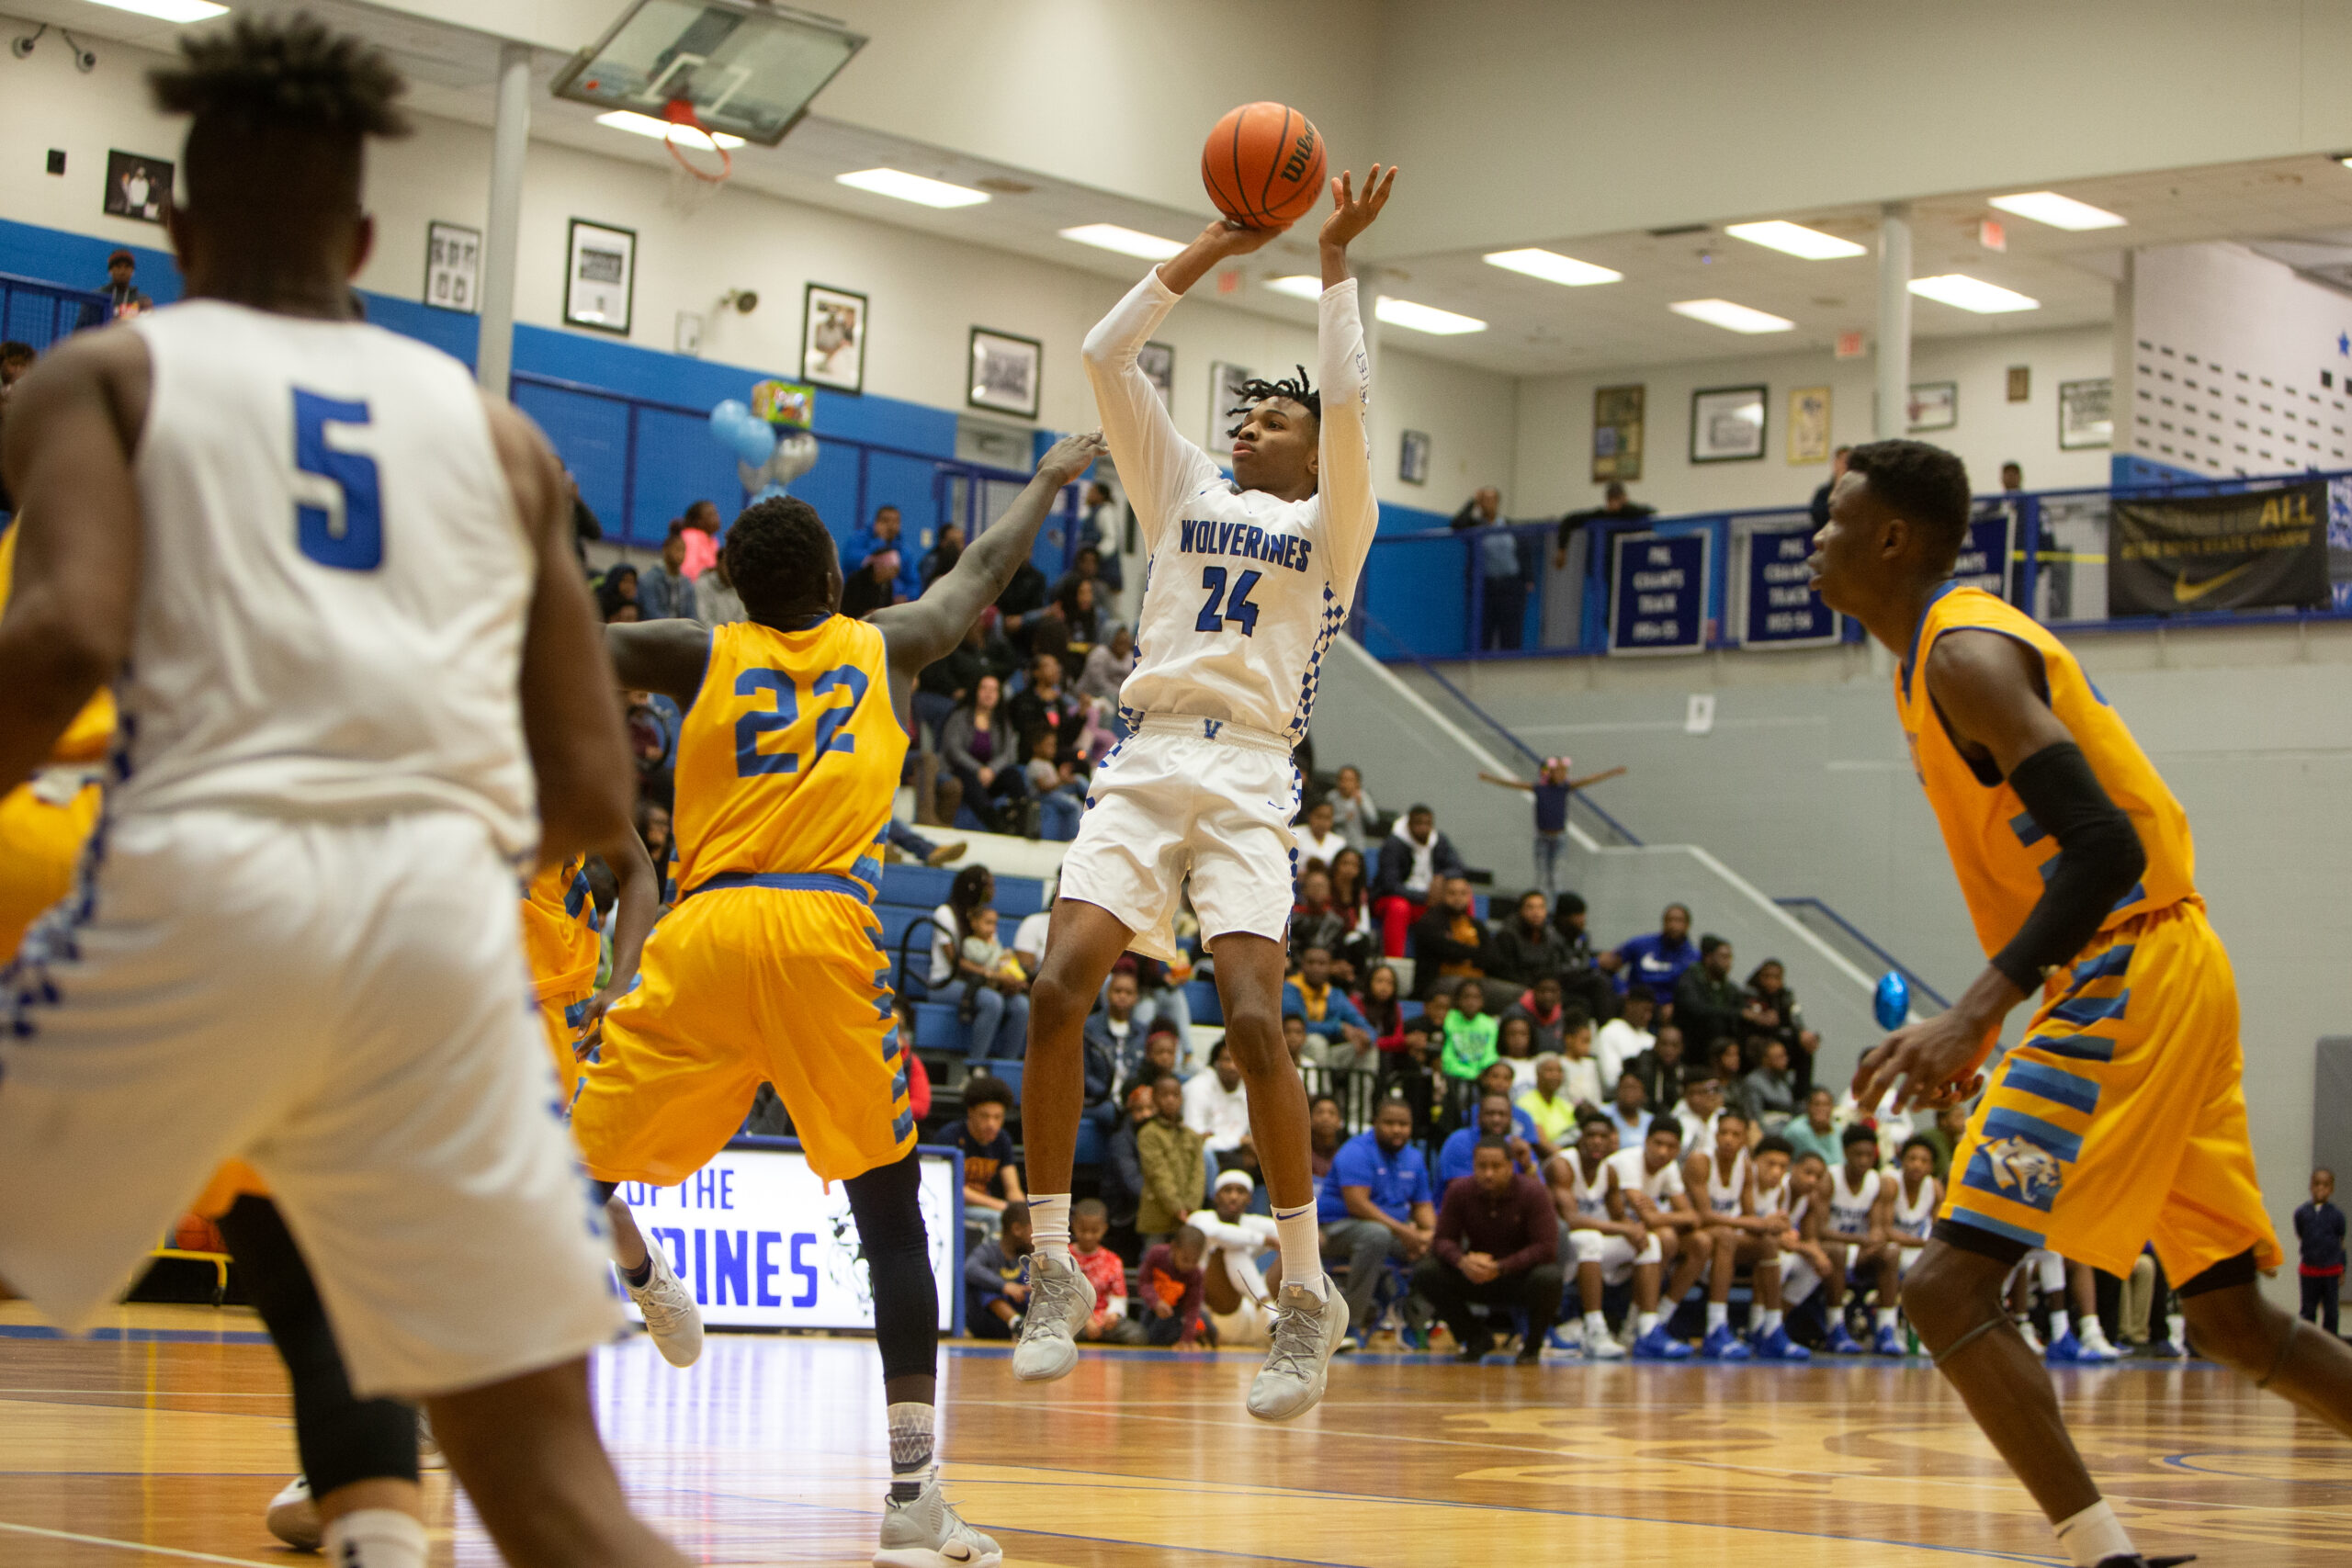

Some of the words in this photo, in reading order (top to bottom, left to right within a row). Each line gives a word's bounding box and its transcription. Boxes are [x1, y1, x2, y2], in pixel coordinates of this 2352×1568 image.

[291, 386, 383, 571] 5
[2258, 493, 2315, 527] ALL
[1180, 519, 1312, 573] WOLVERINES
[1764, 562, 1813, 584] CHAMP
[1195, 566, 1263, 637] 24
[733, 663, 869, 778] 22
[1202, 718, 1224, 740] V
